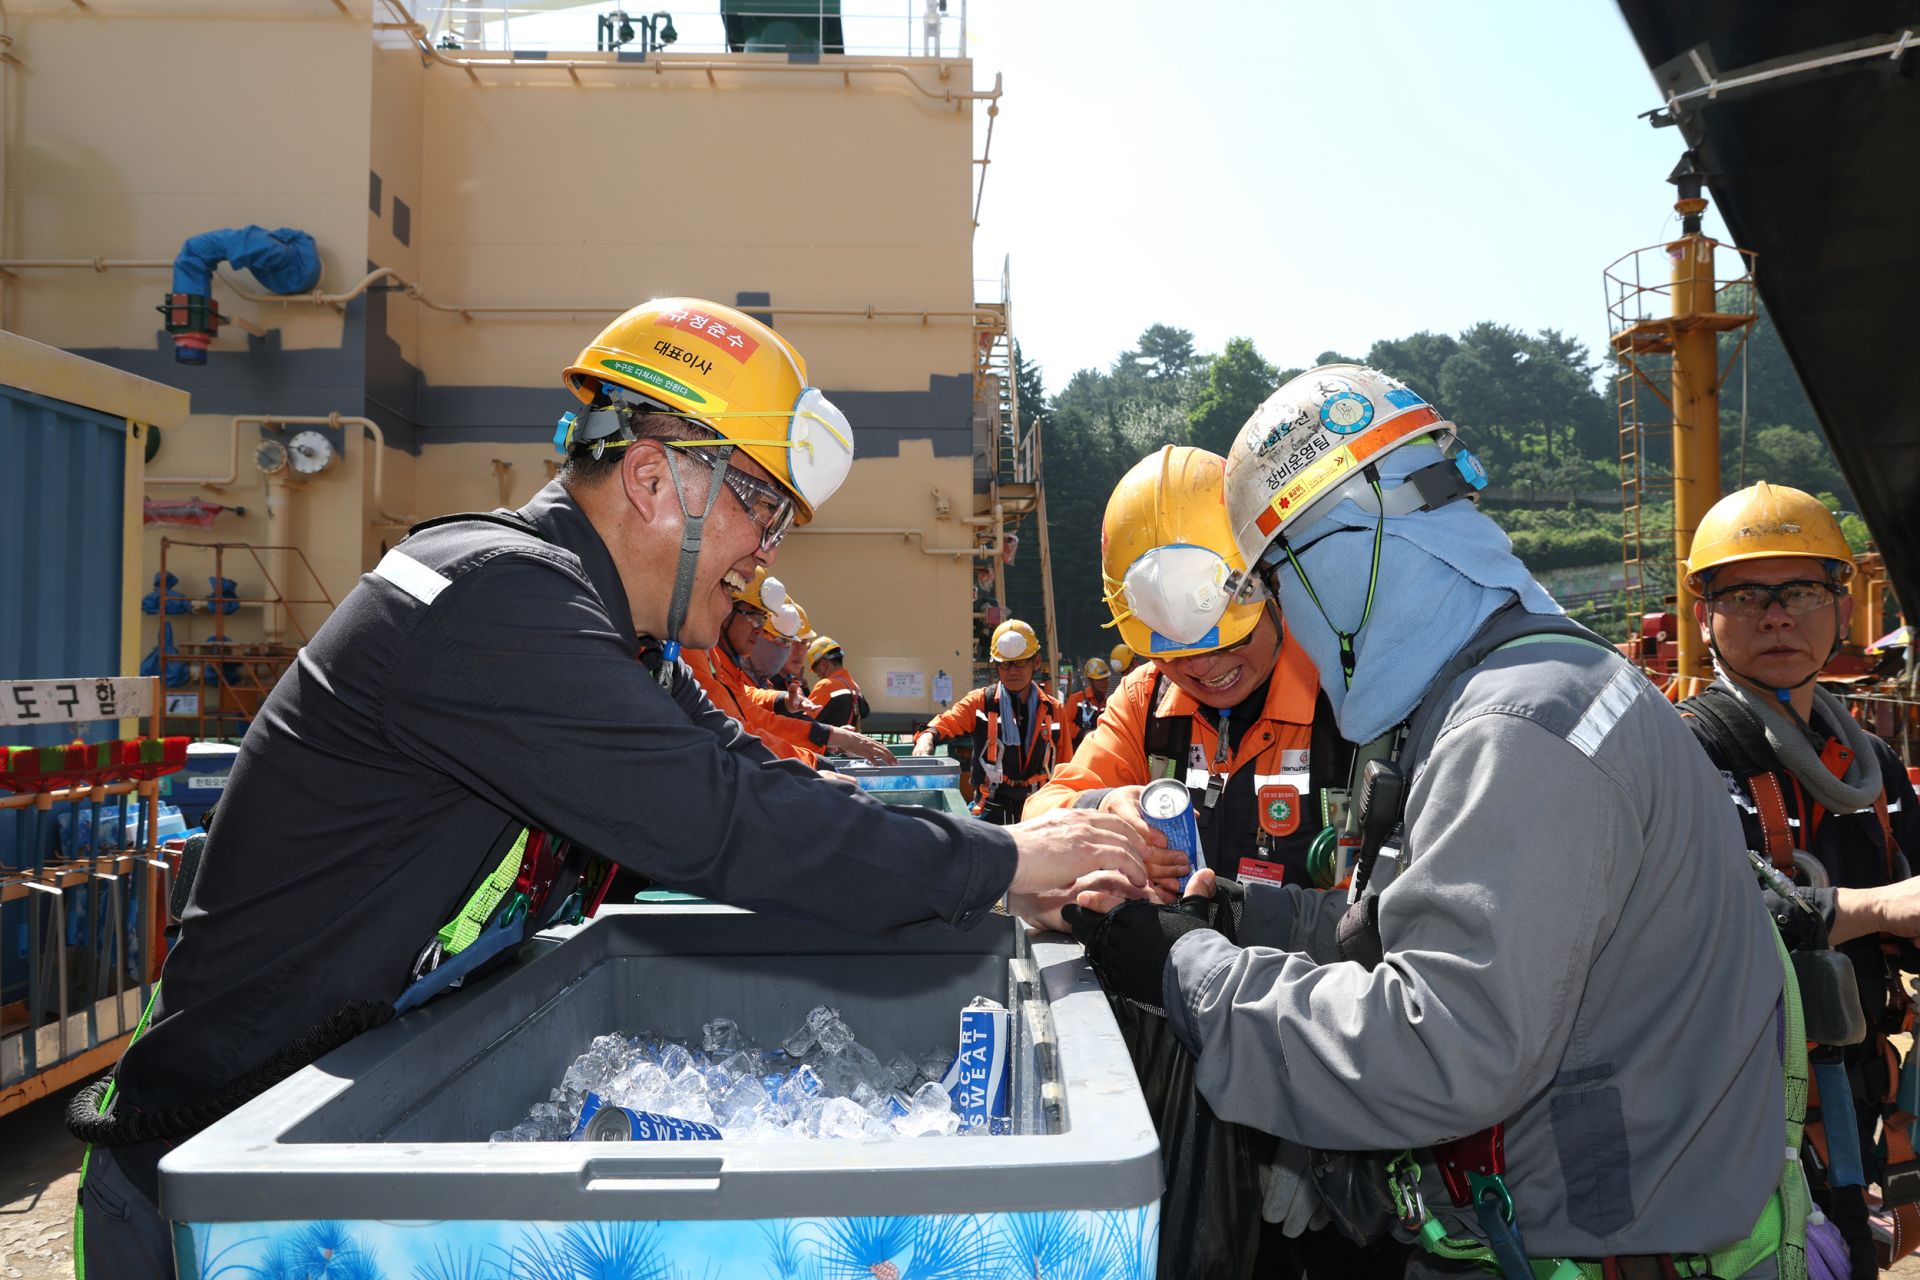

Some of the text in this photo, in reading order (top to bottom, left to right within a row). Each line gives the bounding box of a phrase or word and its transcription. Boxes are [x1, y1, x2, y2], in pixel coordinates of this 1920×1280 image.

[669, 310, 745, 348] 규정준수
[654, 340, 713, 375] 대표이사
[614, 361, 634, 373] 누구도
[664, 379, 688, 396] 안된다
[1266, 434, 1330, 490] 장비운영팀
[12, 682, 116, 719] 도구함
[959, 1016, 974, 1126] POCARI
[970, 1029, 987, 1128] SWEAT
